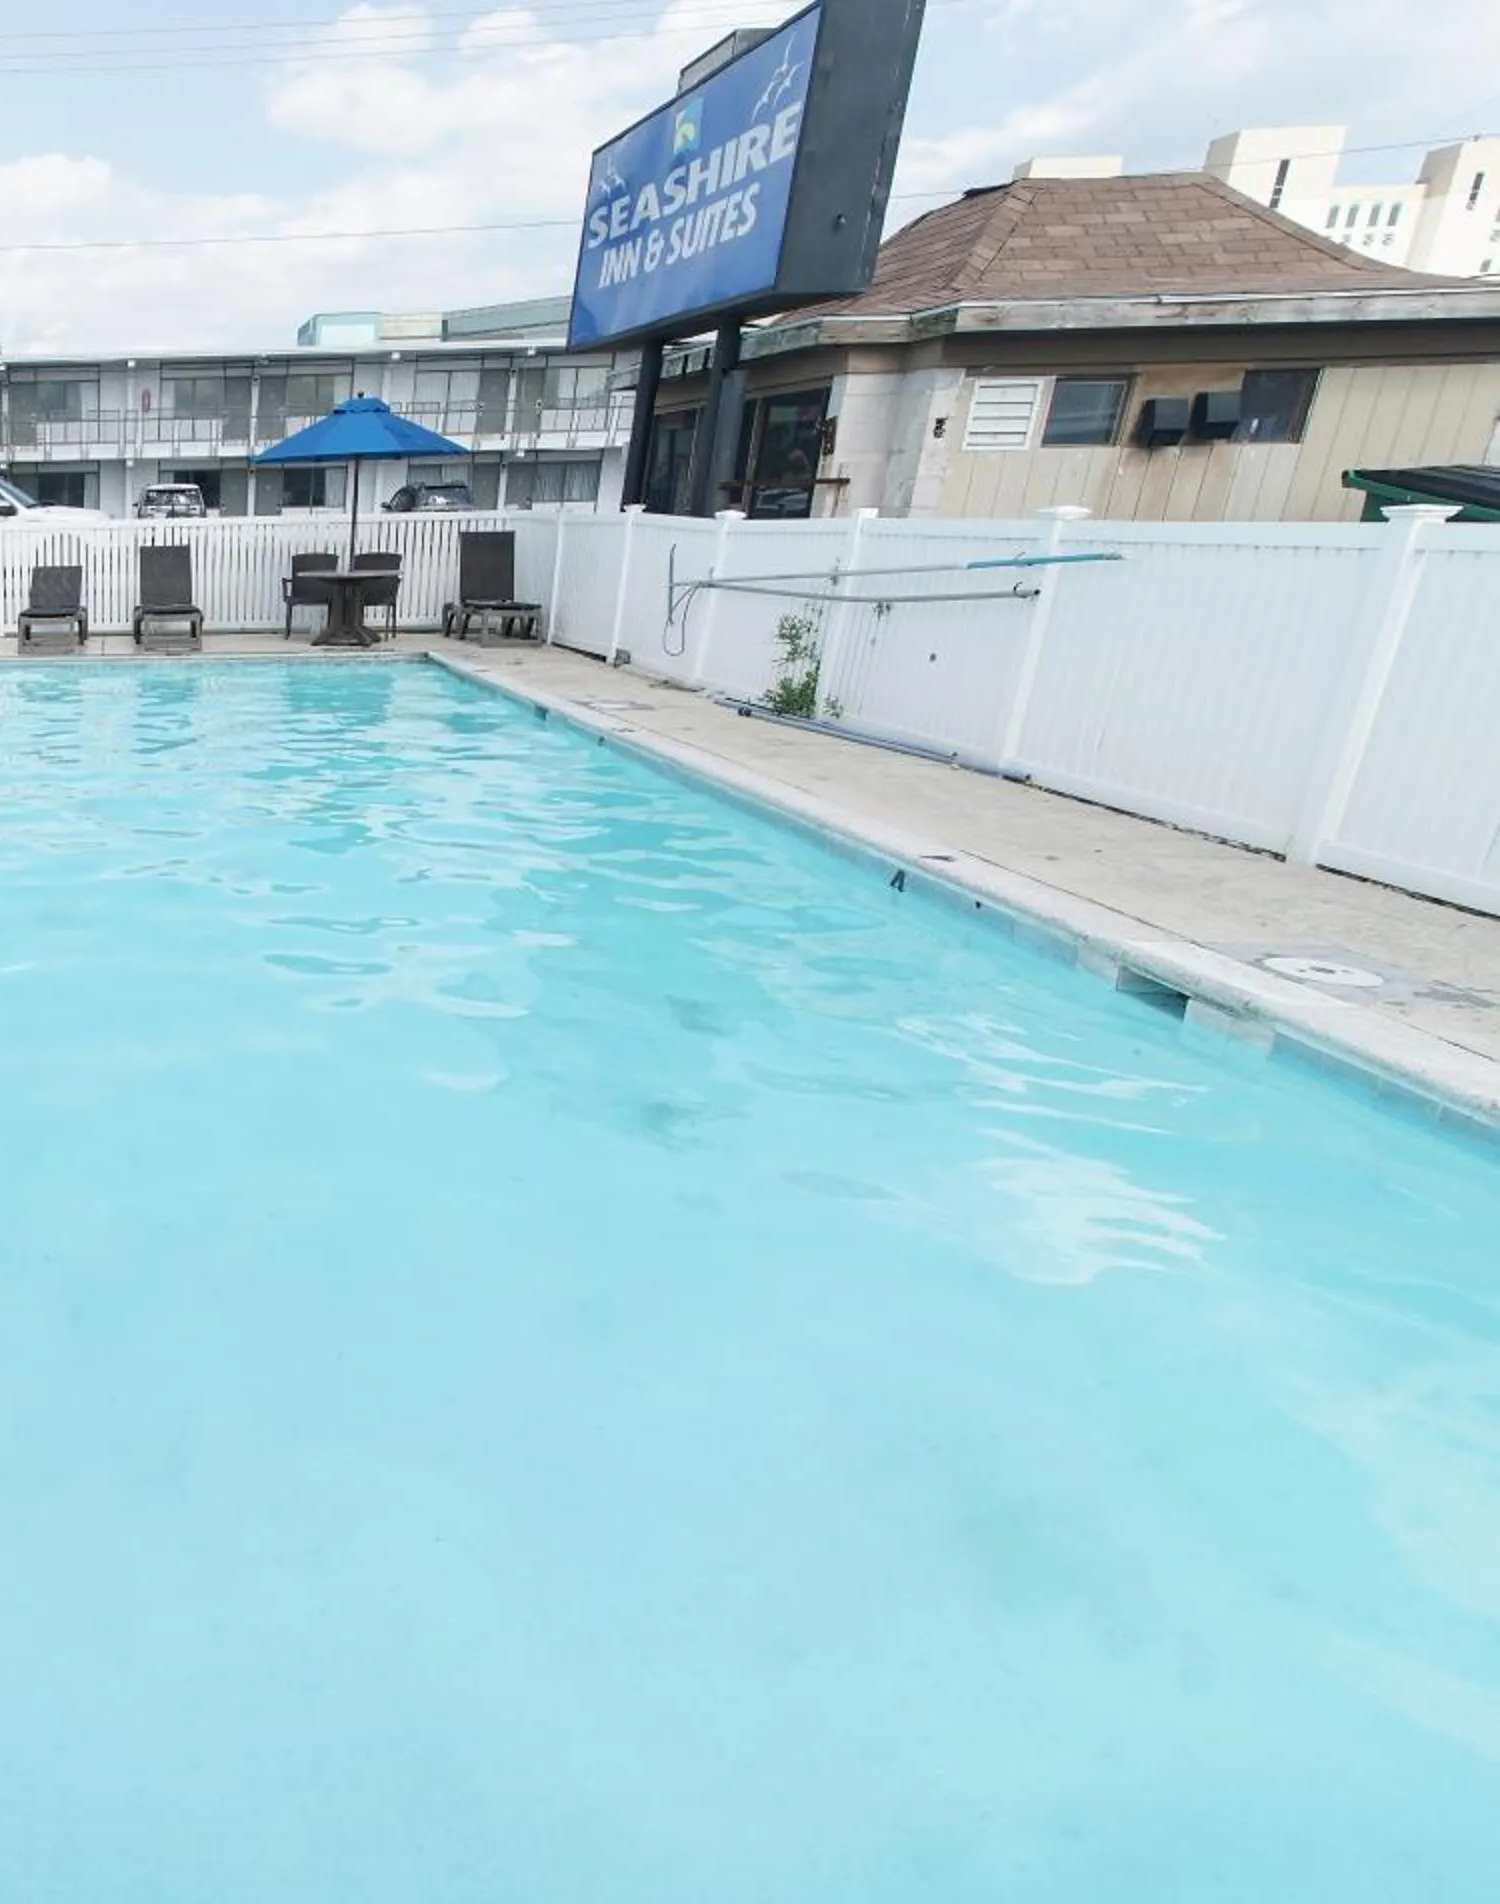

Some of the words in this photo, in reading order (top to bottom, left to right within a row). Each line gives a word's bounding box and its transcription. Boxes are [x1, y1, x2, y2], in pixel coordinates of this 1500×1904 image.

[587, 103, 801, 249] SEASHIRE
[598, 235, 642, 288] INN
[645, 231, 666, 273] &
[665, 183, 761, 265] SUITES
